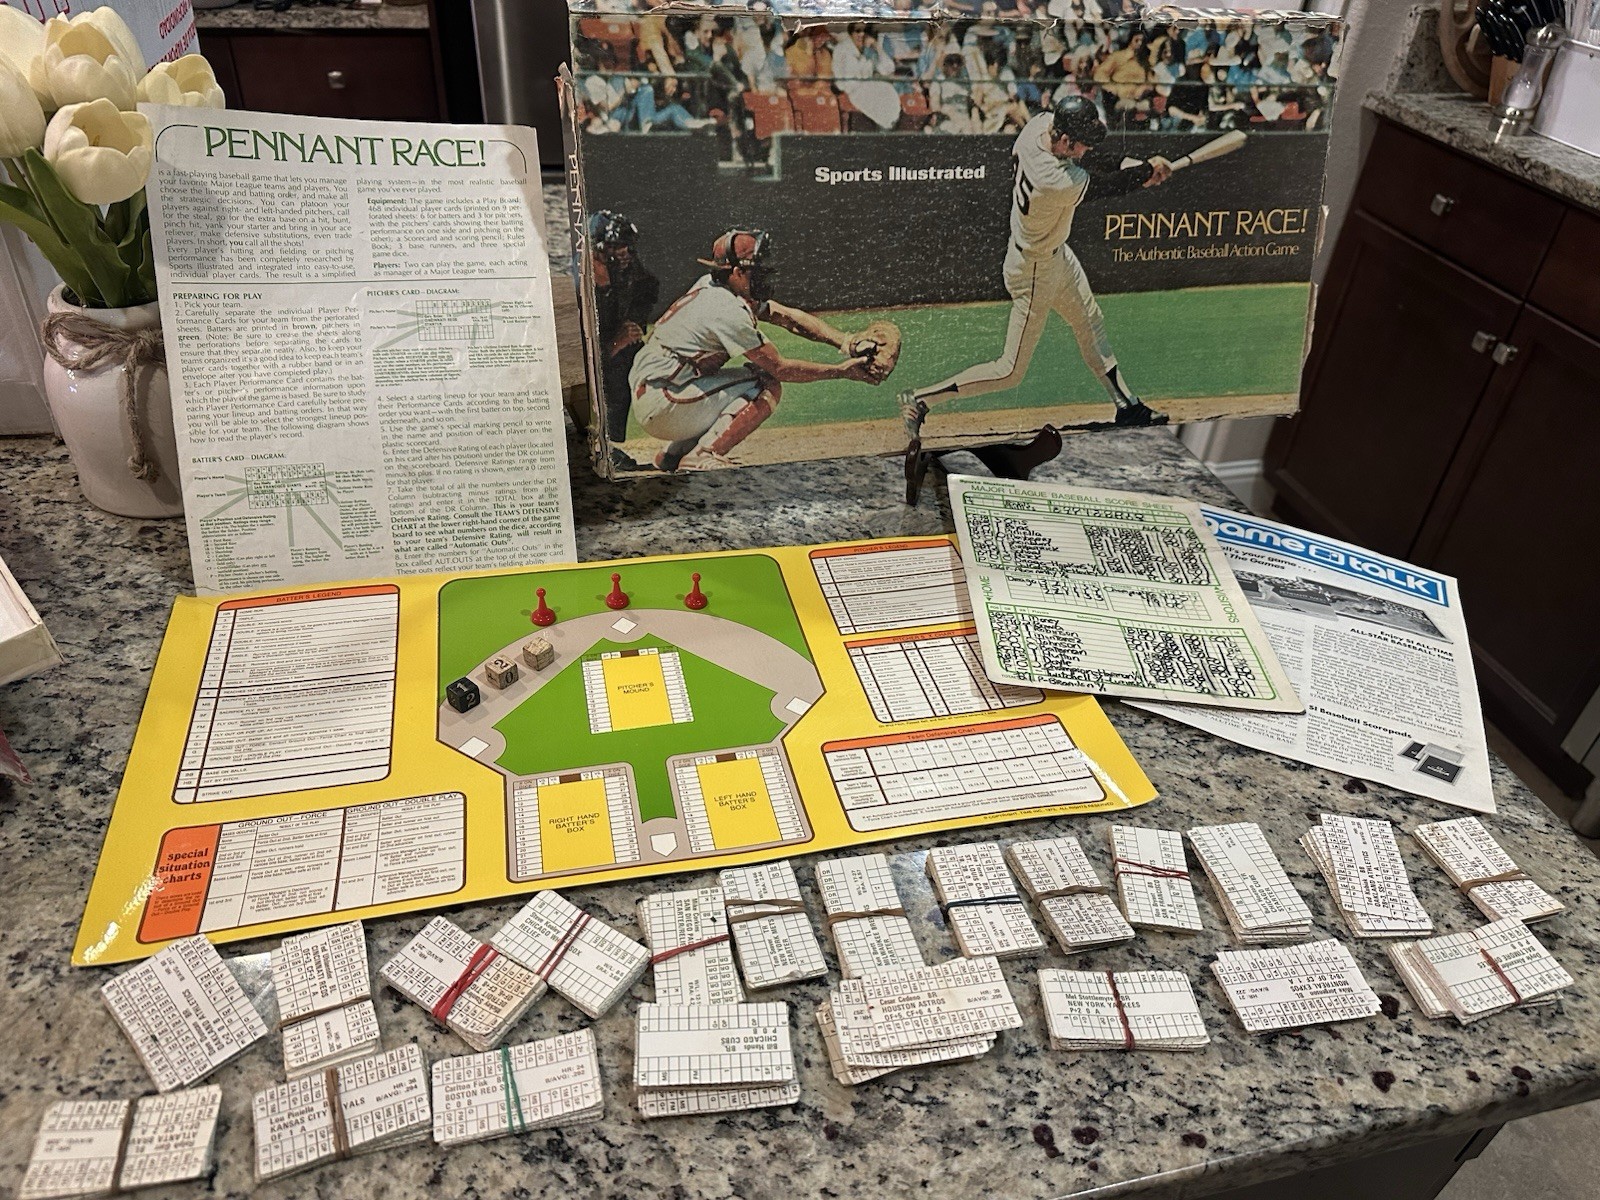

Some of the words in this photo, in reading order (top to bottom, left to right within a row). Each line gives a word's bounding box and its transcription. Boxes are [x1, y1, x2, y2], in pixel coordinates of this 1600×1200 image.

[203, 126, 384, 166] PENNANT
[390, 138, 486, 167] RACE!
[173, 170, 218, 179] fast-playing
[219, 172, 250, 180] baseball
[274, 174, 288, 182] that
[815, 167, 882, 185] Sports
[889, 165, 986, 181] Illustrated
[1104, 211, 1230, 240] PENNANT
[1236, 208, 1309, 236] RACE!
[1112, 249, 1134, 262] The
[1135, 246, 1186, 261] Authentic
[1187, 243, 1230, 259] Baseball
[1229, 244, 1265, 257] Action
[1266, 242, 1299, 256] Game
[507, 259, 528, 267] acting
[173, 292, 219, 300] PREPARING
[970, 484, 1006, 494] MAJOR
[1008, 488, 1048, 498] LEAGUE
[1052, 492, 1099, 503] BASEBALL
[1104, 497, 1139, 506] SCORE
[1142, 502, 1174, 511] SHEET
[1230, 553, 1248, 561] The
[1250, 557, 1285, 570] Games
[1241, 551, 1265, 559] your
[1267, 556, 1297, 567] game
[980, 575, 993, 600] HOME
[1218, 589, 1240, 624] VISITORS
[1350, 628, 1389, 643] ALL-STAR
[1437, 654, 1454, 662] too!
[1380, 630, 1404, 641] Enjoy
[1416, 640, 1453, 657] ALL-TIME
[506, 672, 514, 683] 0
[617, 681, 654, 690] PITCHER'S
[467, 693, 476, 707] 2
[1320, 708, 1360, 725] Baseball
[1363, 720, 1412, 738] Scorepads
[926, 729, 959, 737] Defensive
[347, 805, 382, 814] GROUND
[439, 793, 458, 801] PLAY
[714, 794, 736, 802] LEFT
[738, 791, 758, 799] HAND
[718, 797, 756, 808] BATTER'S
[730, 803, 748, 811] BOX
[238, 818, 274, 828] GROUND
[548, 816, 575, 826] RIGHT
[576, 812, 600, 821] HAND
[555, 819, 596, 830] BATTER'S
[566, 826, 586, 834] BOX
[167, 848, 209, 862] special
[159, 859, 210, 873] situation
[1362, 851, 1374, 879] ATHLETICS
[163, 871, 202, 884] charts
[1249, 875, 1261, 891] CUBS
[1154, 880, 1166, 907] FRANCISCO
[1369, 880, 1381, 907] OAKLAND
[1257, 893, 1277, 913] CHICAGO
[524, 918, 550, 936] CHICAGO
[685, 913, 693, 931] DIEGO
[768, 918, 777, 934] METS
[519, 924, 541, 939] RELIEF
[774, 936, 783, 952] YORK
[782, 939, 797, 965] STARTER
[873, 932, 891, 966] MILWAUKEE
[884, 939, 898, 965] STARTER
[779, 954, 789, 966] NEW
[312, 945, 324, 980] CINCINNATI
[319, 981, 328, 998] REDS
[1312, 980, 1350, 989] MONTREAL
[182, 988, 206, 1020] ATHLETICS
[882, 1004, 916, 1013] HOUSTON
[918, 999, 946, 1009] ASTROS
[202, 1019, 224, 1051] OAKLAND
[445, 1083, 471, 1093] Carlton
[473, 1080, 488, 1088] Fisk
[445, 1090, 477, 1101] BOSTON
[480, 1086, 497, 1095] RED
[270, 1118, 305, 1133] KANSAS
[307, 1110, 328, 1122] CITY
